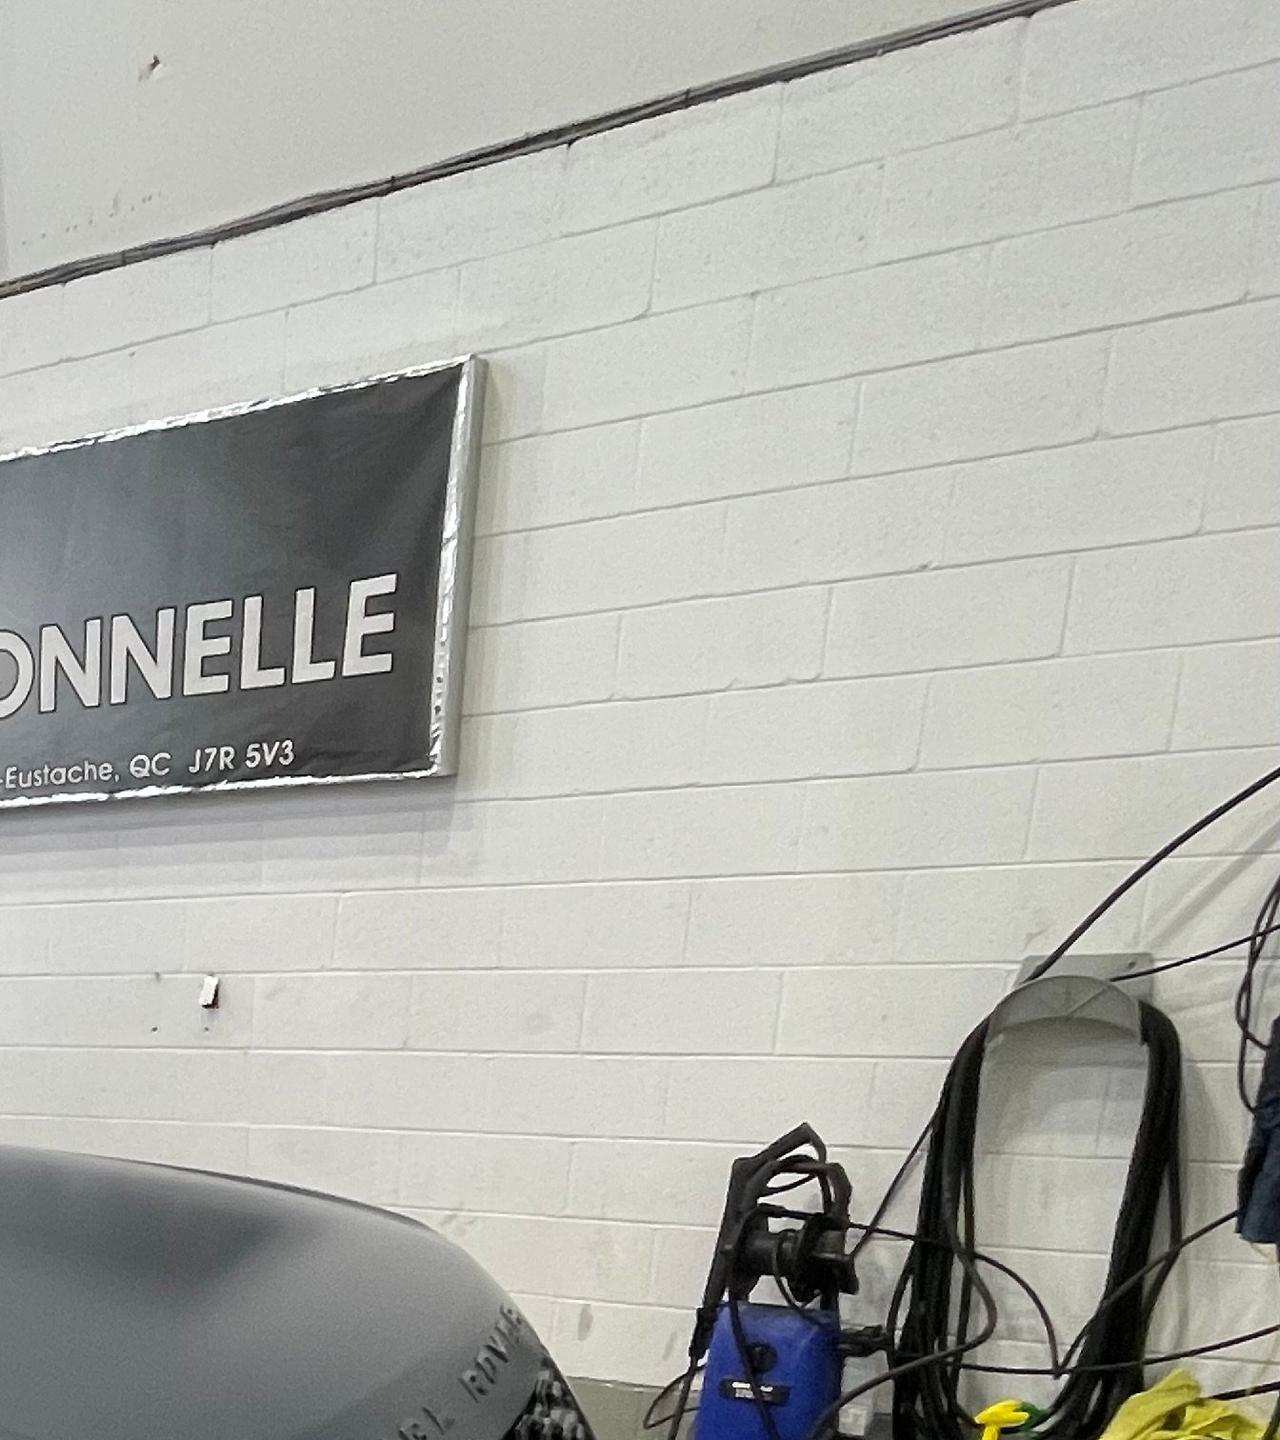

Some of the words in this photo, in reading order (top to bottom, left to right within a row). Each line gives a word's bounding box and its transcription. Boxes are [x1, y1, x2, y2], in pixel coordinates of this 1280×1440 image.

[129, 752, 172, 778] QC
[188, 746, 235, 775] J7R
[244, 740, 295, 769] 5V3
